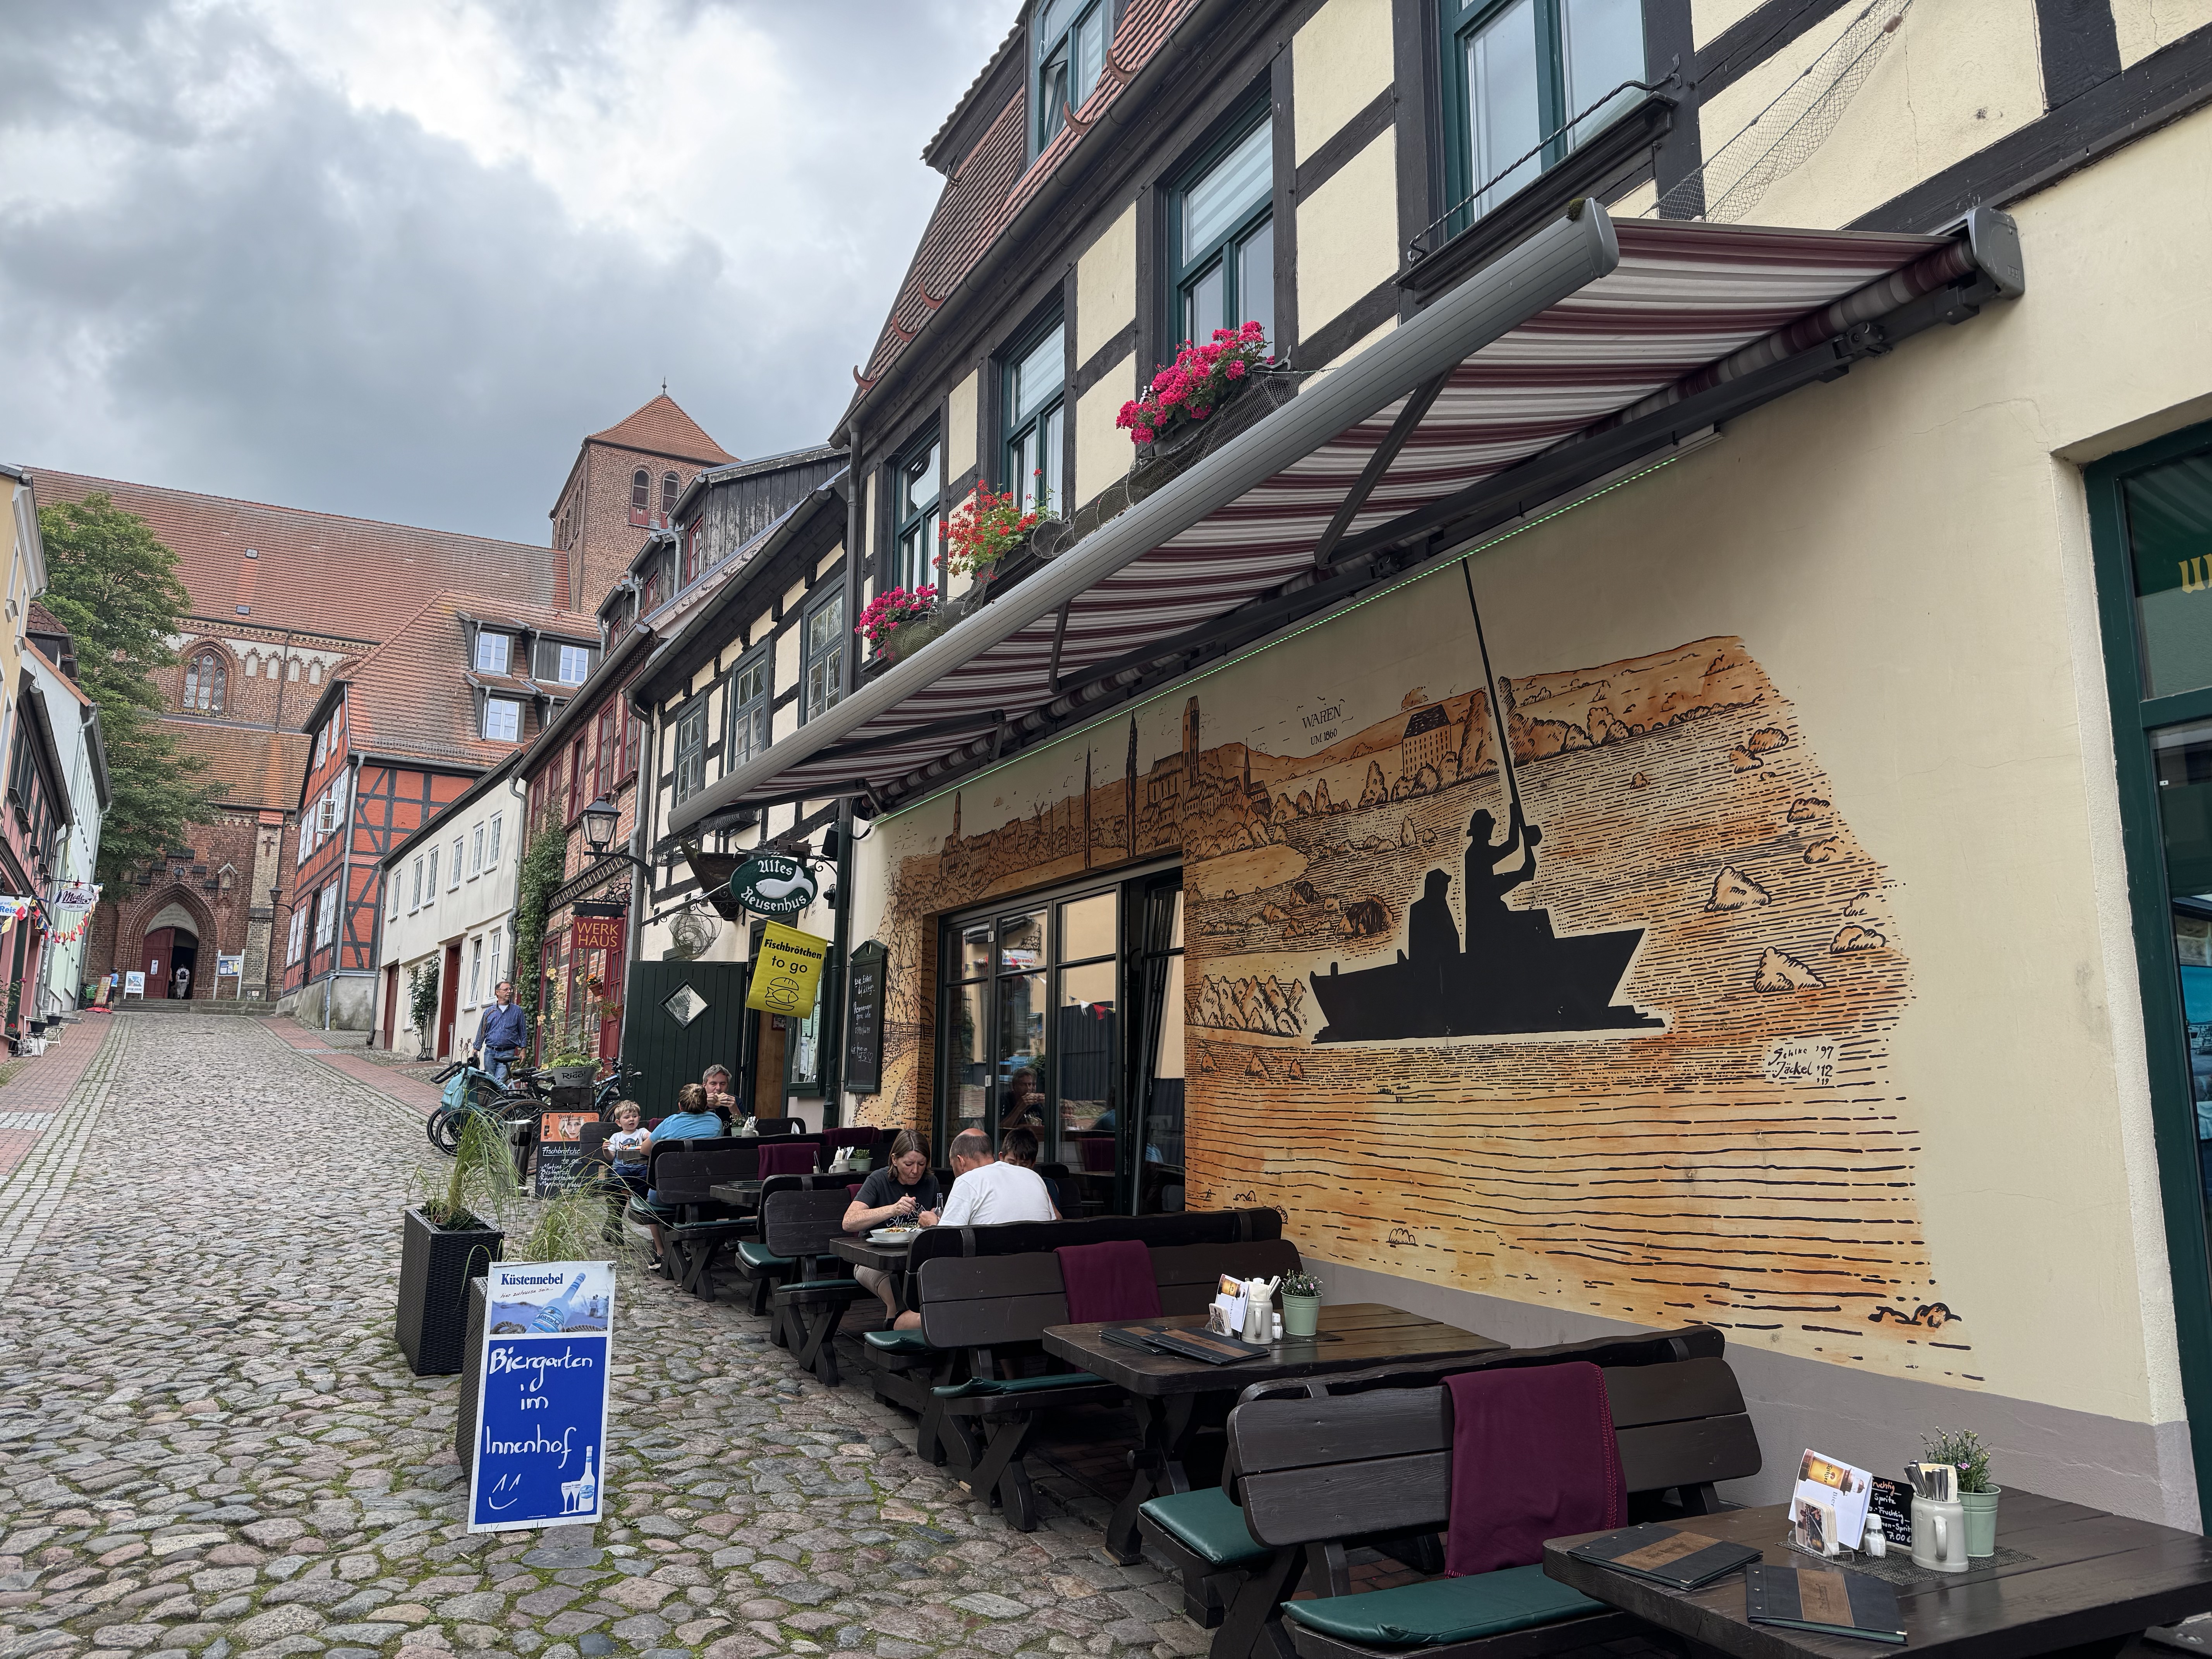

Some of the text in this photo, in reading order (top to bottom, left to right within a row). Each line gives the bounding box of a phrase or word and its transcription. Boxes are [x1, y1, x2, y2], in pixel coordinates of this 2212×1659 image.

[1302, 704, 1341, 729] WAREN
[1310, 728, 1337, 745] UM 1860
[758, 859, 793, 876] Altes
[62, 891, 84, 902] Mode
[740, 886, 807, 913] Reusenhus
[577, 922, 619, 935] WERK
[578, 934, 618, 947] HAUS
[764, 939, 822, 960] Fischbrötchen
[772, 955, 808, 974] to go
[1772, 1061, 1833, 1078] Jäckel '12
[501, 1273, 563, 1285] Küstennebel
[489, 1346, 592, 1392] Biergarten
[520, 1384, 549, 1410] im
[486, 1424, 577, 1469] Innenhof
[1872, 1481, 1895, 1496] ruchtig
